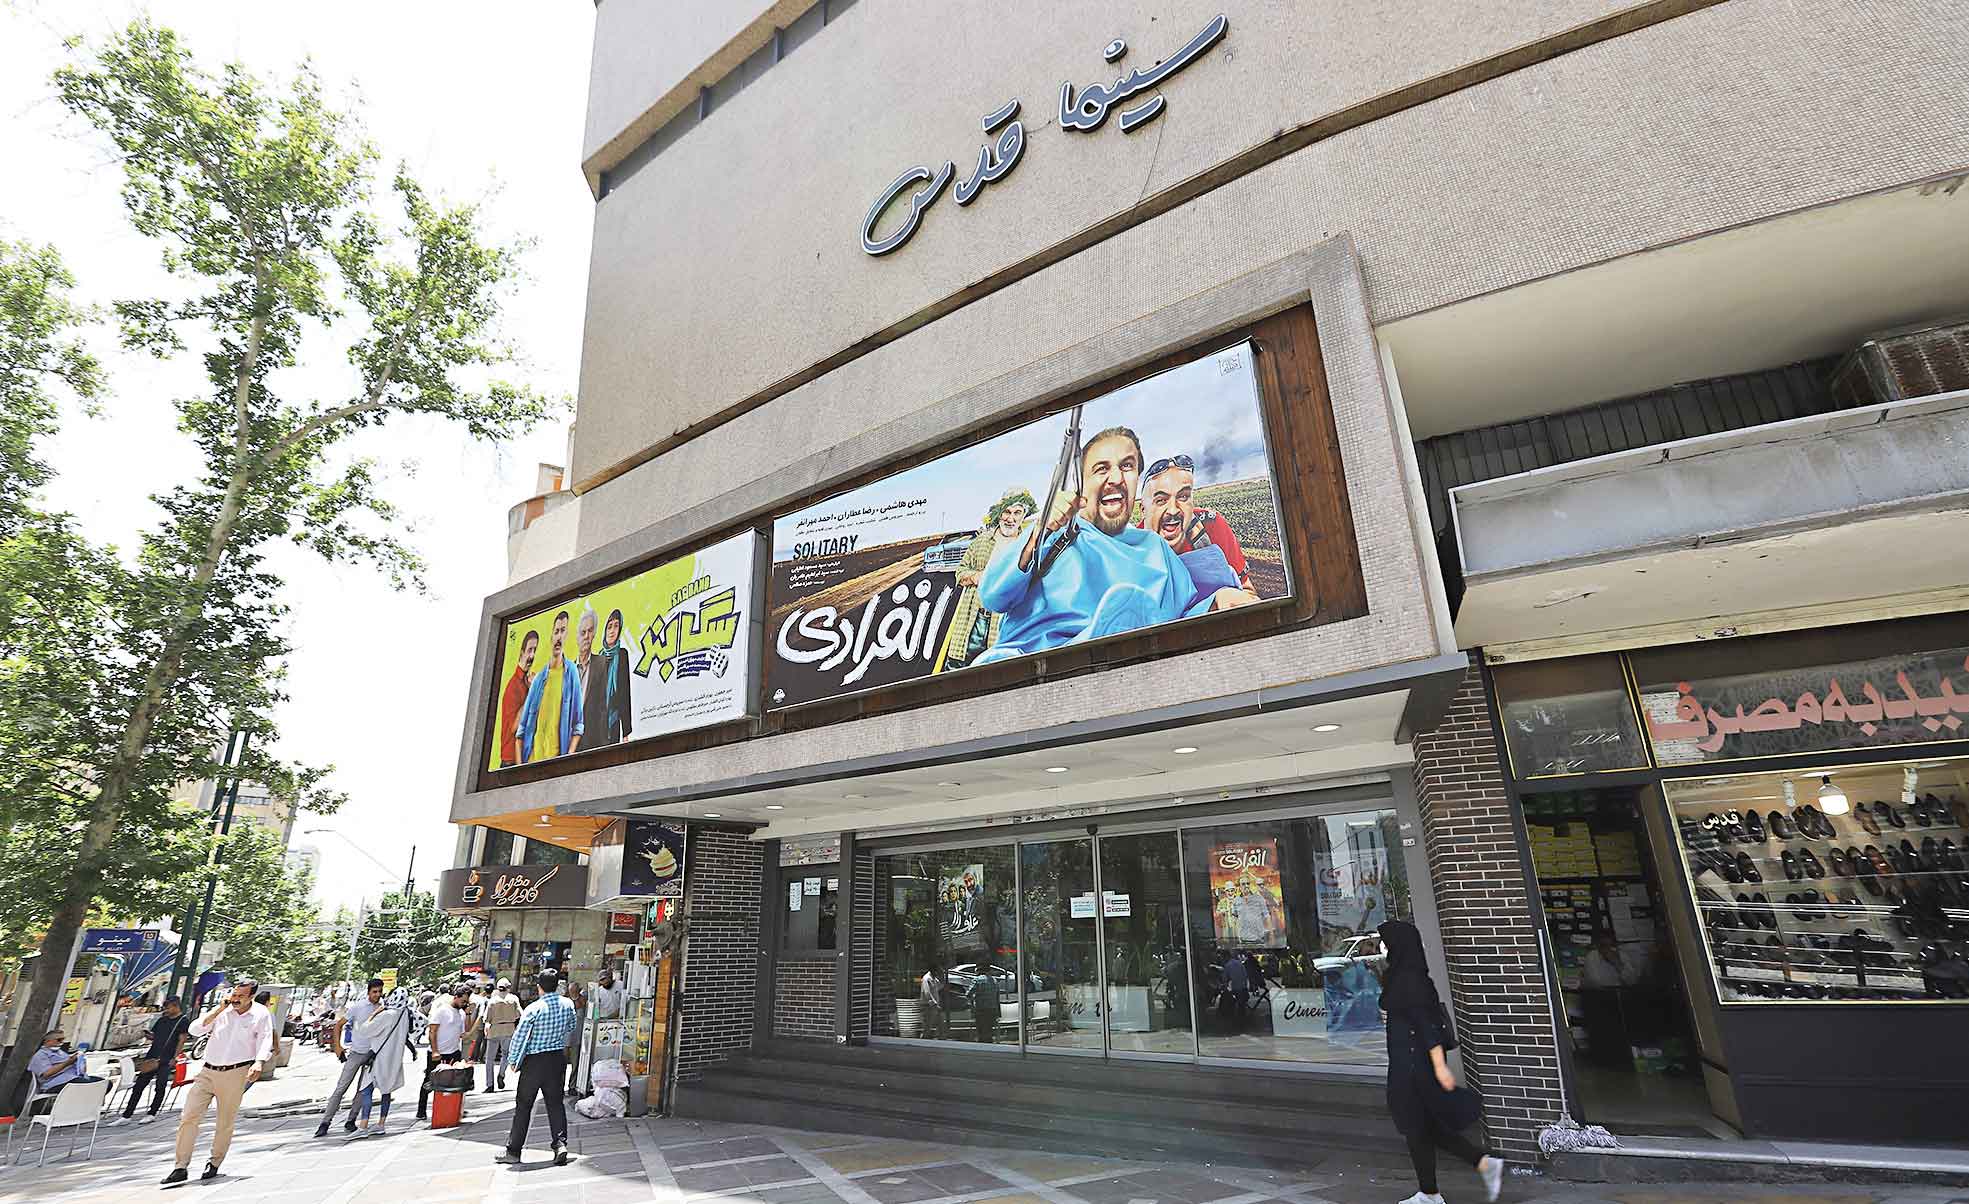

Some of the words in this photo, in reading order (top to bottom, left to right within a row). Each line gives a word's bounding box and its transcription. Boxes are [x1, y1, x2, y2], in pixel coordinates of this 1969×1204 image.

[1058, 14, 1230, 134] سینما
[861, 98, 1028, 256] قدس
[837, 509, 861, 521] عطاران
[863, 506, 877, 516] رضا
[880, 500, 906, 513] هاشمی
[818, 514, 834, 523] احمد
[793, 534, 859, 560] SOLITARY
[777, 579, 953, 686] انفرادی
[1646, 681, 1824, 753] مصرف
[1702, 808, 1742, 830] قدس
[1219, 848, 1267, 873] انفرادی
[1284, 1001, 1328, 1020] Cinem
